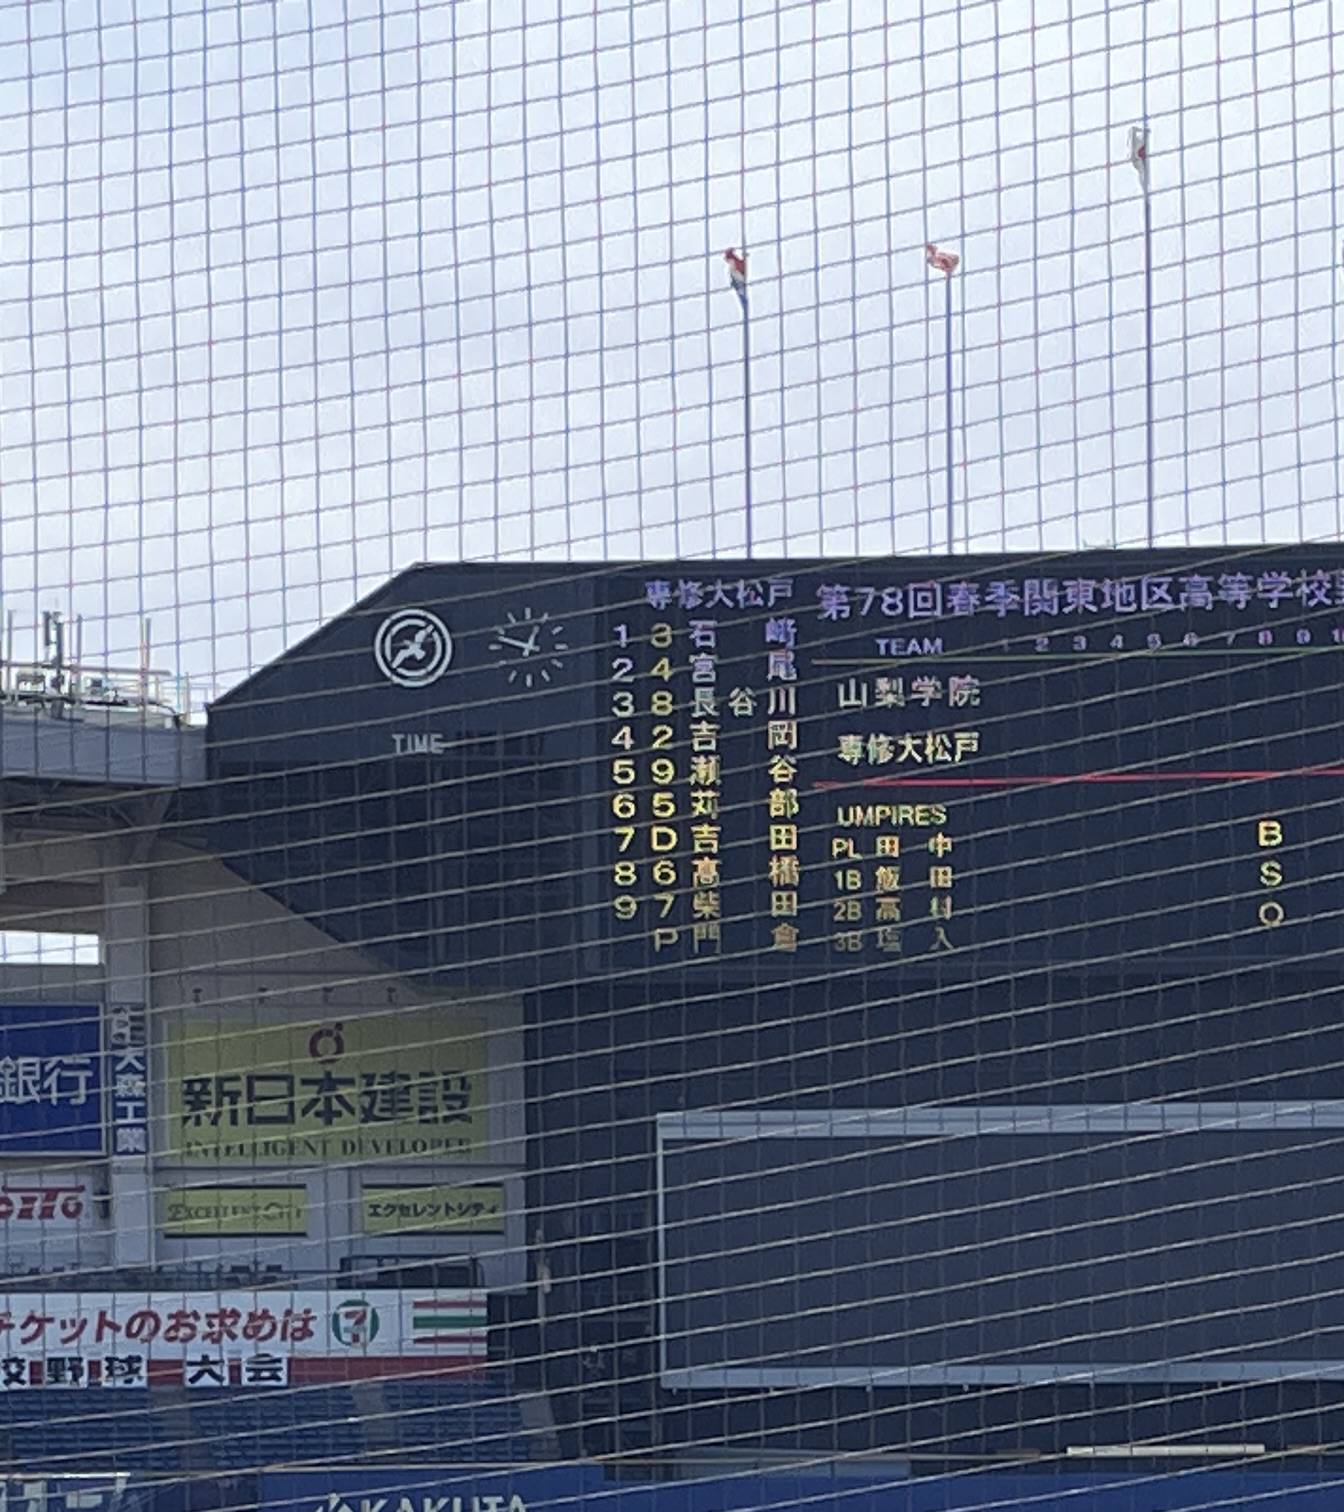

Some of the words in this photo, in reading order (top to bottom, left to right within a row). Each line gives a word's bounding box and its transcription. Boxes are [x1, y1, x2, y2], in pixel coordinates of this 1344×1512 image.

[644, 577, 794, 610] 専修大松戸
[612, 624, 628, 647] 1
[651, 623, 672, 648] 3
[875, 636, 944, 655] TEAM
[612, 658, 634, 682] 2
[651, 657, 672, 682] 4
[837, 675, 981, 708] 山梨学院
[613, 692, 635, 717] 3
[651, 692, 673, 716] 8
[392, 733, 445, 753] TIME
[612, 726, 634, 750] 4
[652, 725, 674, 750] 2
[838, 731, 981, 766] 専修大松戸
[613, 759, 635, 785] 5
[652, 758, 675, 785] 9
[613, 793, 636, 818] 6
[653, 793, 676, 818] 5
[836, 804, 947, 827] UMPIRES
[614, 826, 636, 852] 7
[651, 826, 678, 851] D
[1258, 819, 1283, 846] B
[832, 837, 863, 859] PL
[615, 861, 637, 886] 8
[653, 860, 676, 885] 6
[834, 869, 863, 891] 1B
[1260, 860, 1283, 886] S
[615, 894, 637, 919] 9
[654, 893, 674, 919] 7
[833, 900, 863, 922] 2B
[1258, 901, 1284, 927] O
[654, 928, 678, 952] P
[181, 1070, 473, 1127] 新日本建設
